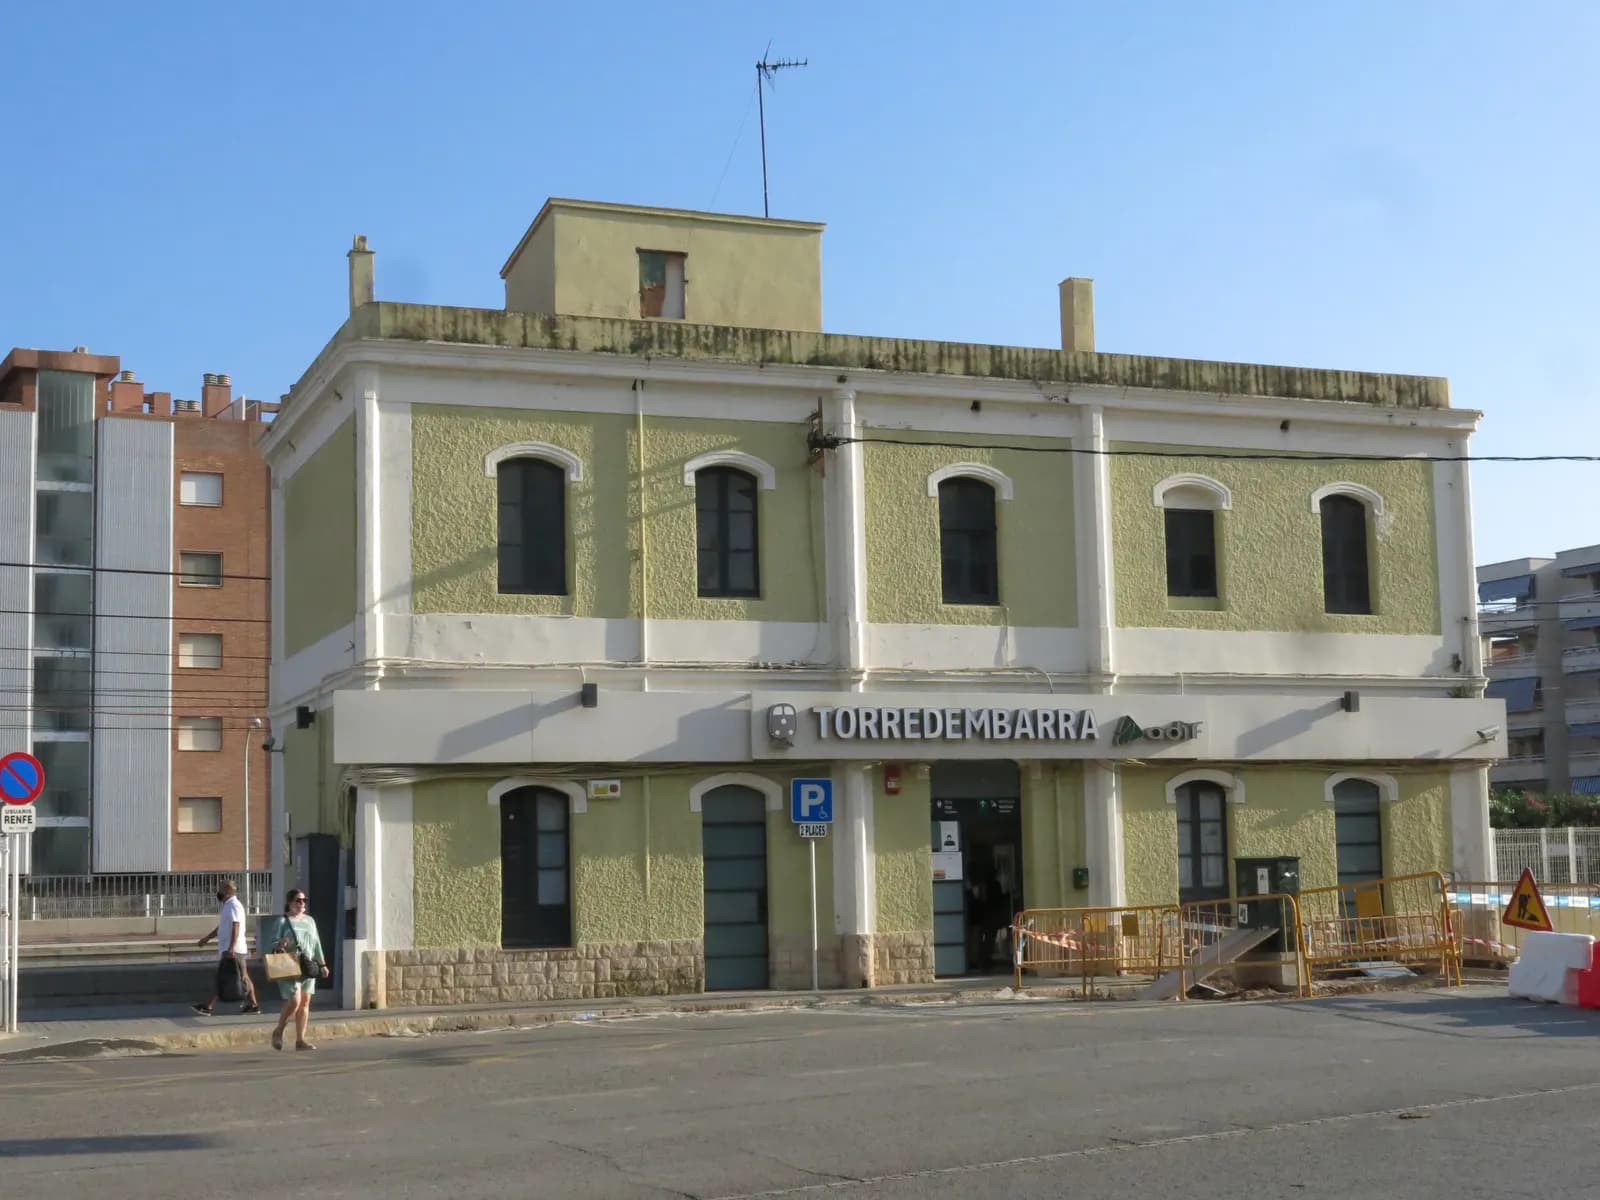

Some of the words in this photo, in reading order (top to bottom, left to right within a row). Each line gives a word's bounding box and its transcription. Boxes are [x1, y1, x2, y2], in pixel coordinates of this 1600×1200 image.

[812, 706, 1100, 741] TORREDEMBARRA
[801, 784, 825, 816] P
[4, 815, 33, 824] RENFE
